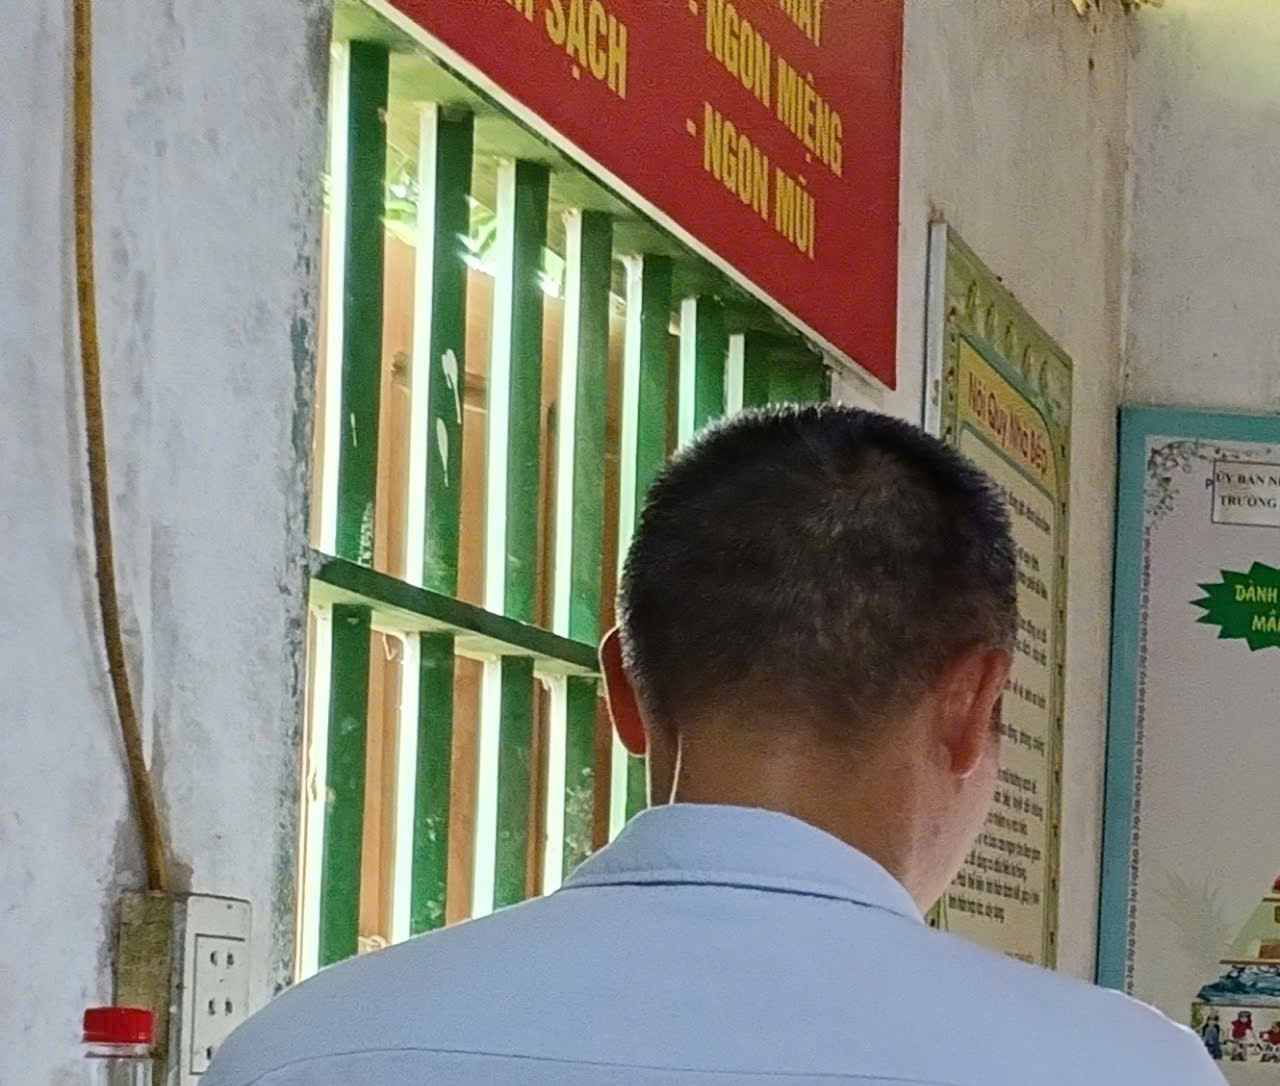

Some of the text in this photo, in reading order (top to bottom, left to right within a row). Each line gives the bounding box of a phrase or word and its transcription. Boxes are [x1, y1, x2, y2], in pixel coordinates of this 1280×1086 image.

[545, 0, 628, 100] SẠCH
[706, 0, 771, 110] NGON
[777, 55, 843, 178] MIỆNG
[704, 101, 769, 222] NGON
[776, 166, 816, 260] MÙI
[1237, 473, 1265, 486] BAN
[1234, 579, 1278, 604] DÀNH
